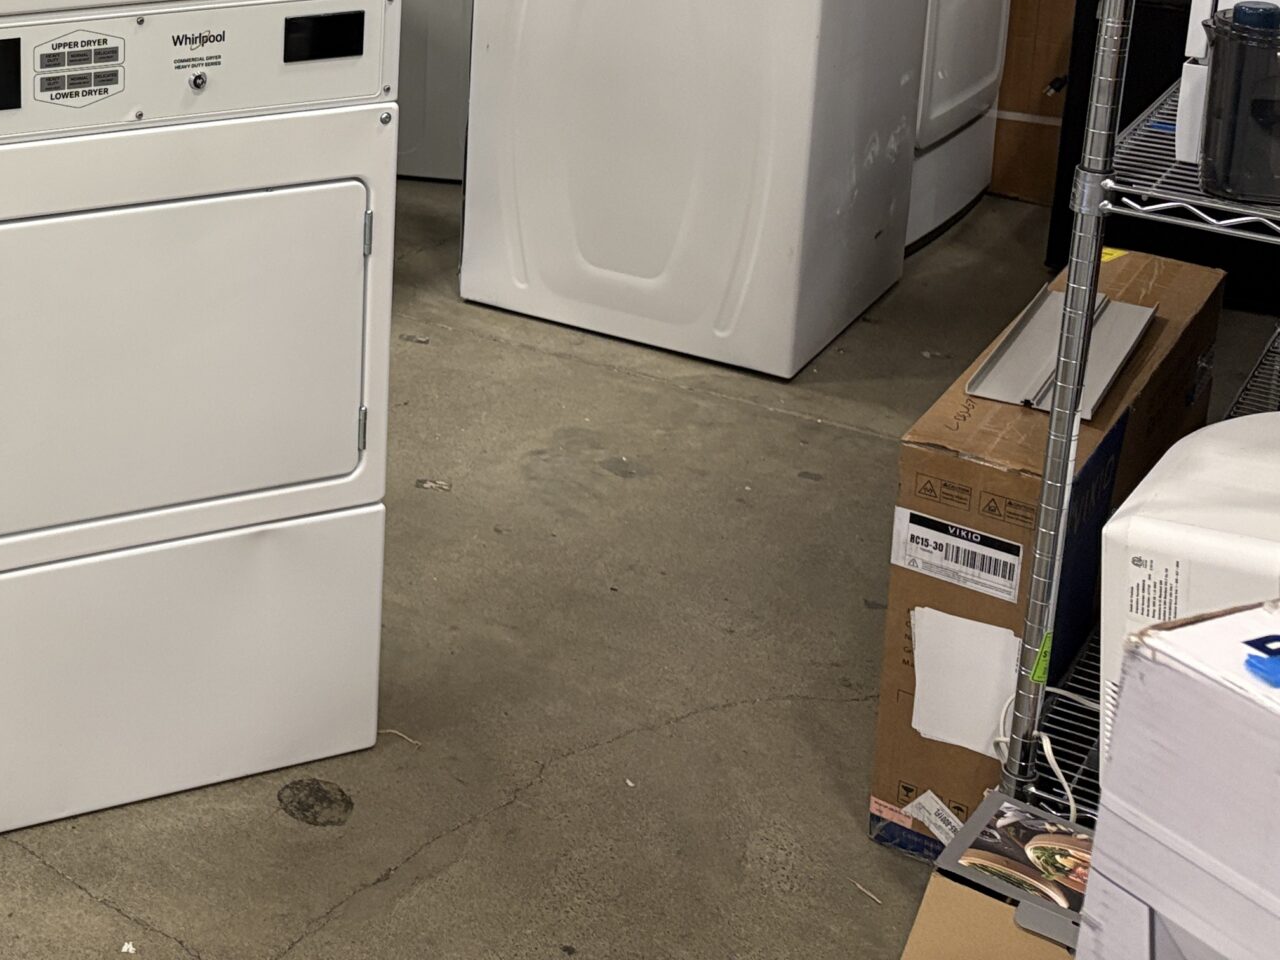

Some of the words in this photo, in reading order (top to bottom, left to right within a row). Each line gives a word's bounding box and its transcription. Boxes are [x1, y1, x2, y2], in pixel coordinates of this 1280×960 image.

[52, 41, 79, 51] UPPER
[81, 38, 108, 48] DRYER
[172, 30, 225, 48] Whirlpool
[50, 91, 80, 101] LOWER
[82, 88, 109, 97] DRYER
[948, 526, 981, 542] VIKIO
